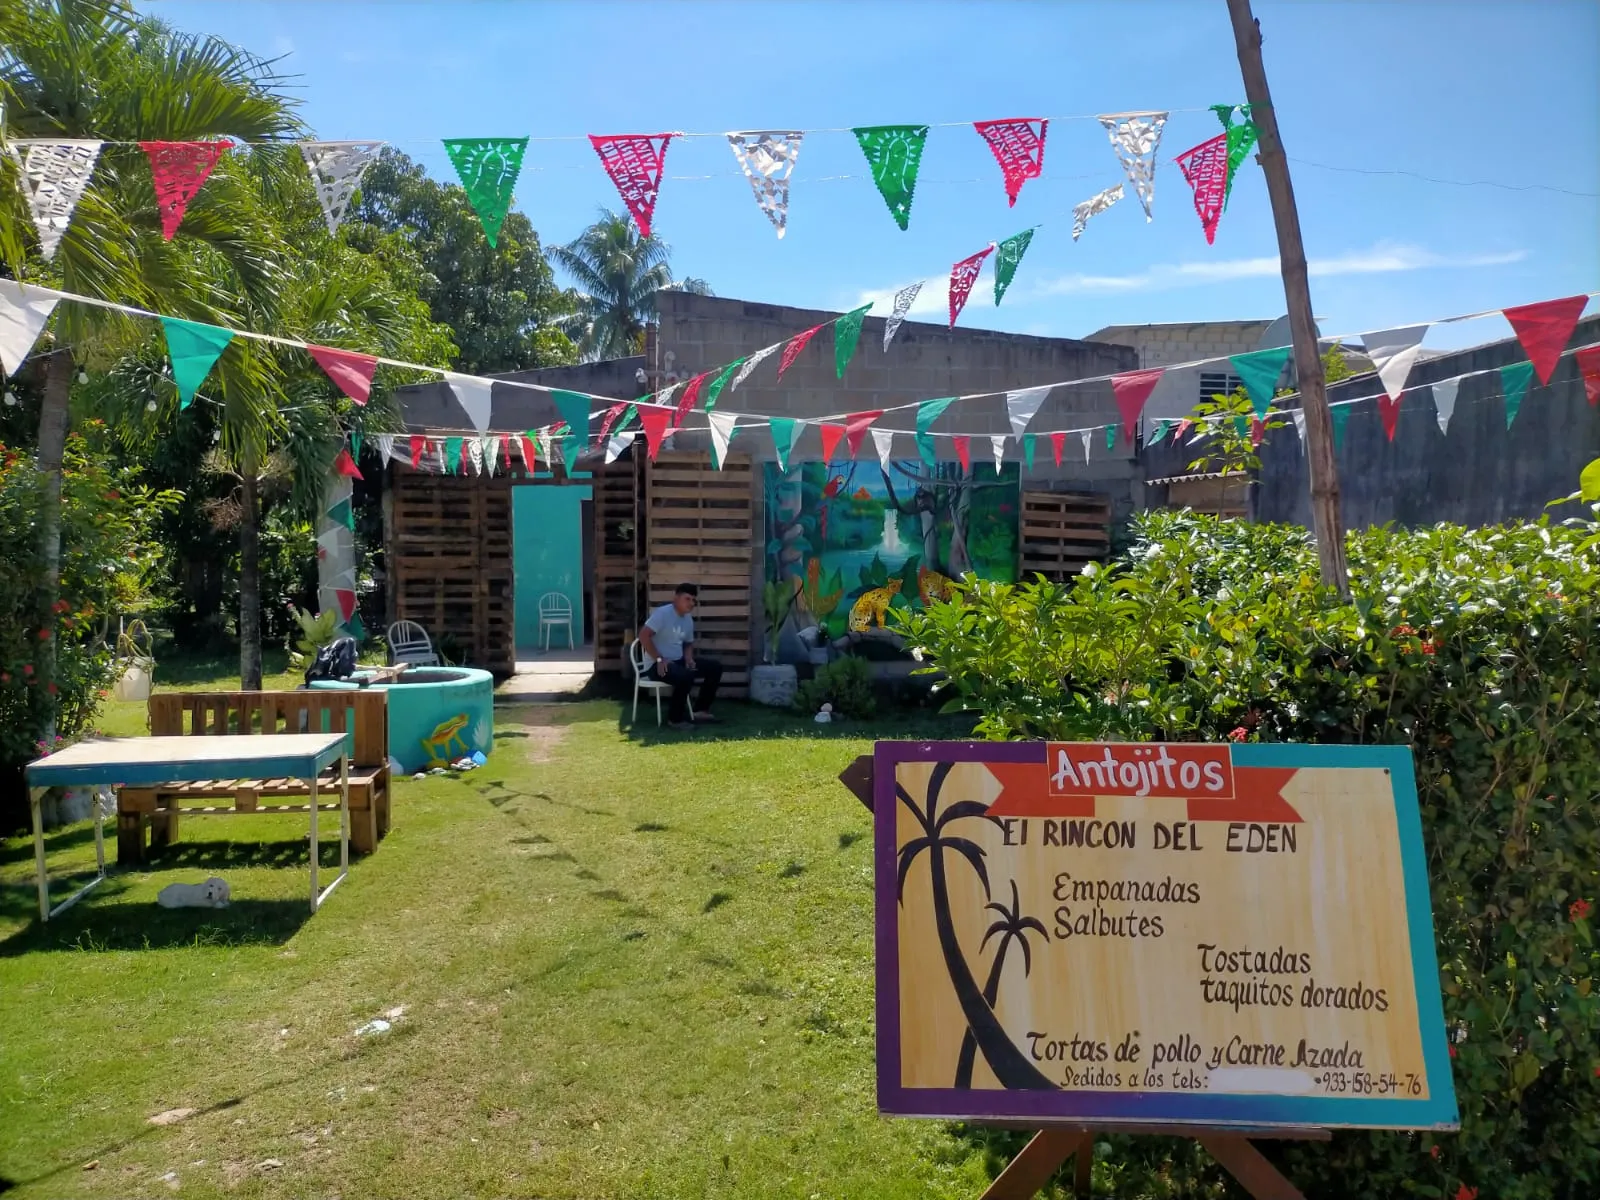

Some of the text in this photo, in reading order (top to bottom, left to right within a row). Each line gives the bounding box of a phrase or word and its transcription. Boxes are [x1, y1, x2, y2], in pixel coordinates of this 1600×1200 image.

[1051, 745, 1224, 797] Antojitos
[1042, 819, 1136, 849] RINCON
[1153, 821, 1203, 850] DEL
[1226, 823, 1297, 853] EDEN
[1053, 872, 1200, 908] Empanadas
[1054, 906, 1164, 939] Salbutes
[1197, 943, 1311, 974] Tostadas
[1200, 975, 1389, 1013] taquitos dorados
[1026, 1032, 1109, 1062] Tortas
[1114, 1033, 1140, 1063] de
[1152, 1033, 1202, 1069] pollo
[1206, 1045, 1225, 1071] y
[1226, 1035, 1285, 1066] Carne
[1128, 1073, 1140, 1087] a
[1144, 1067, 1164, 1088] los
